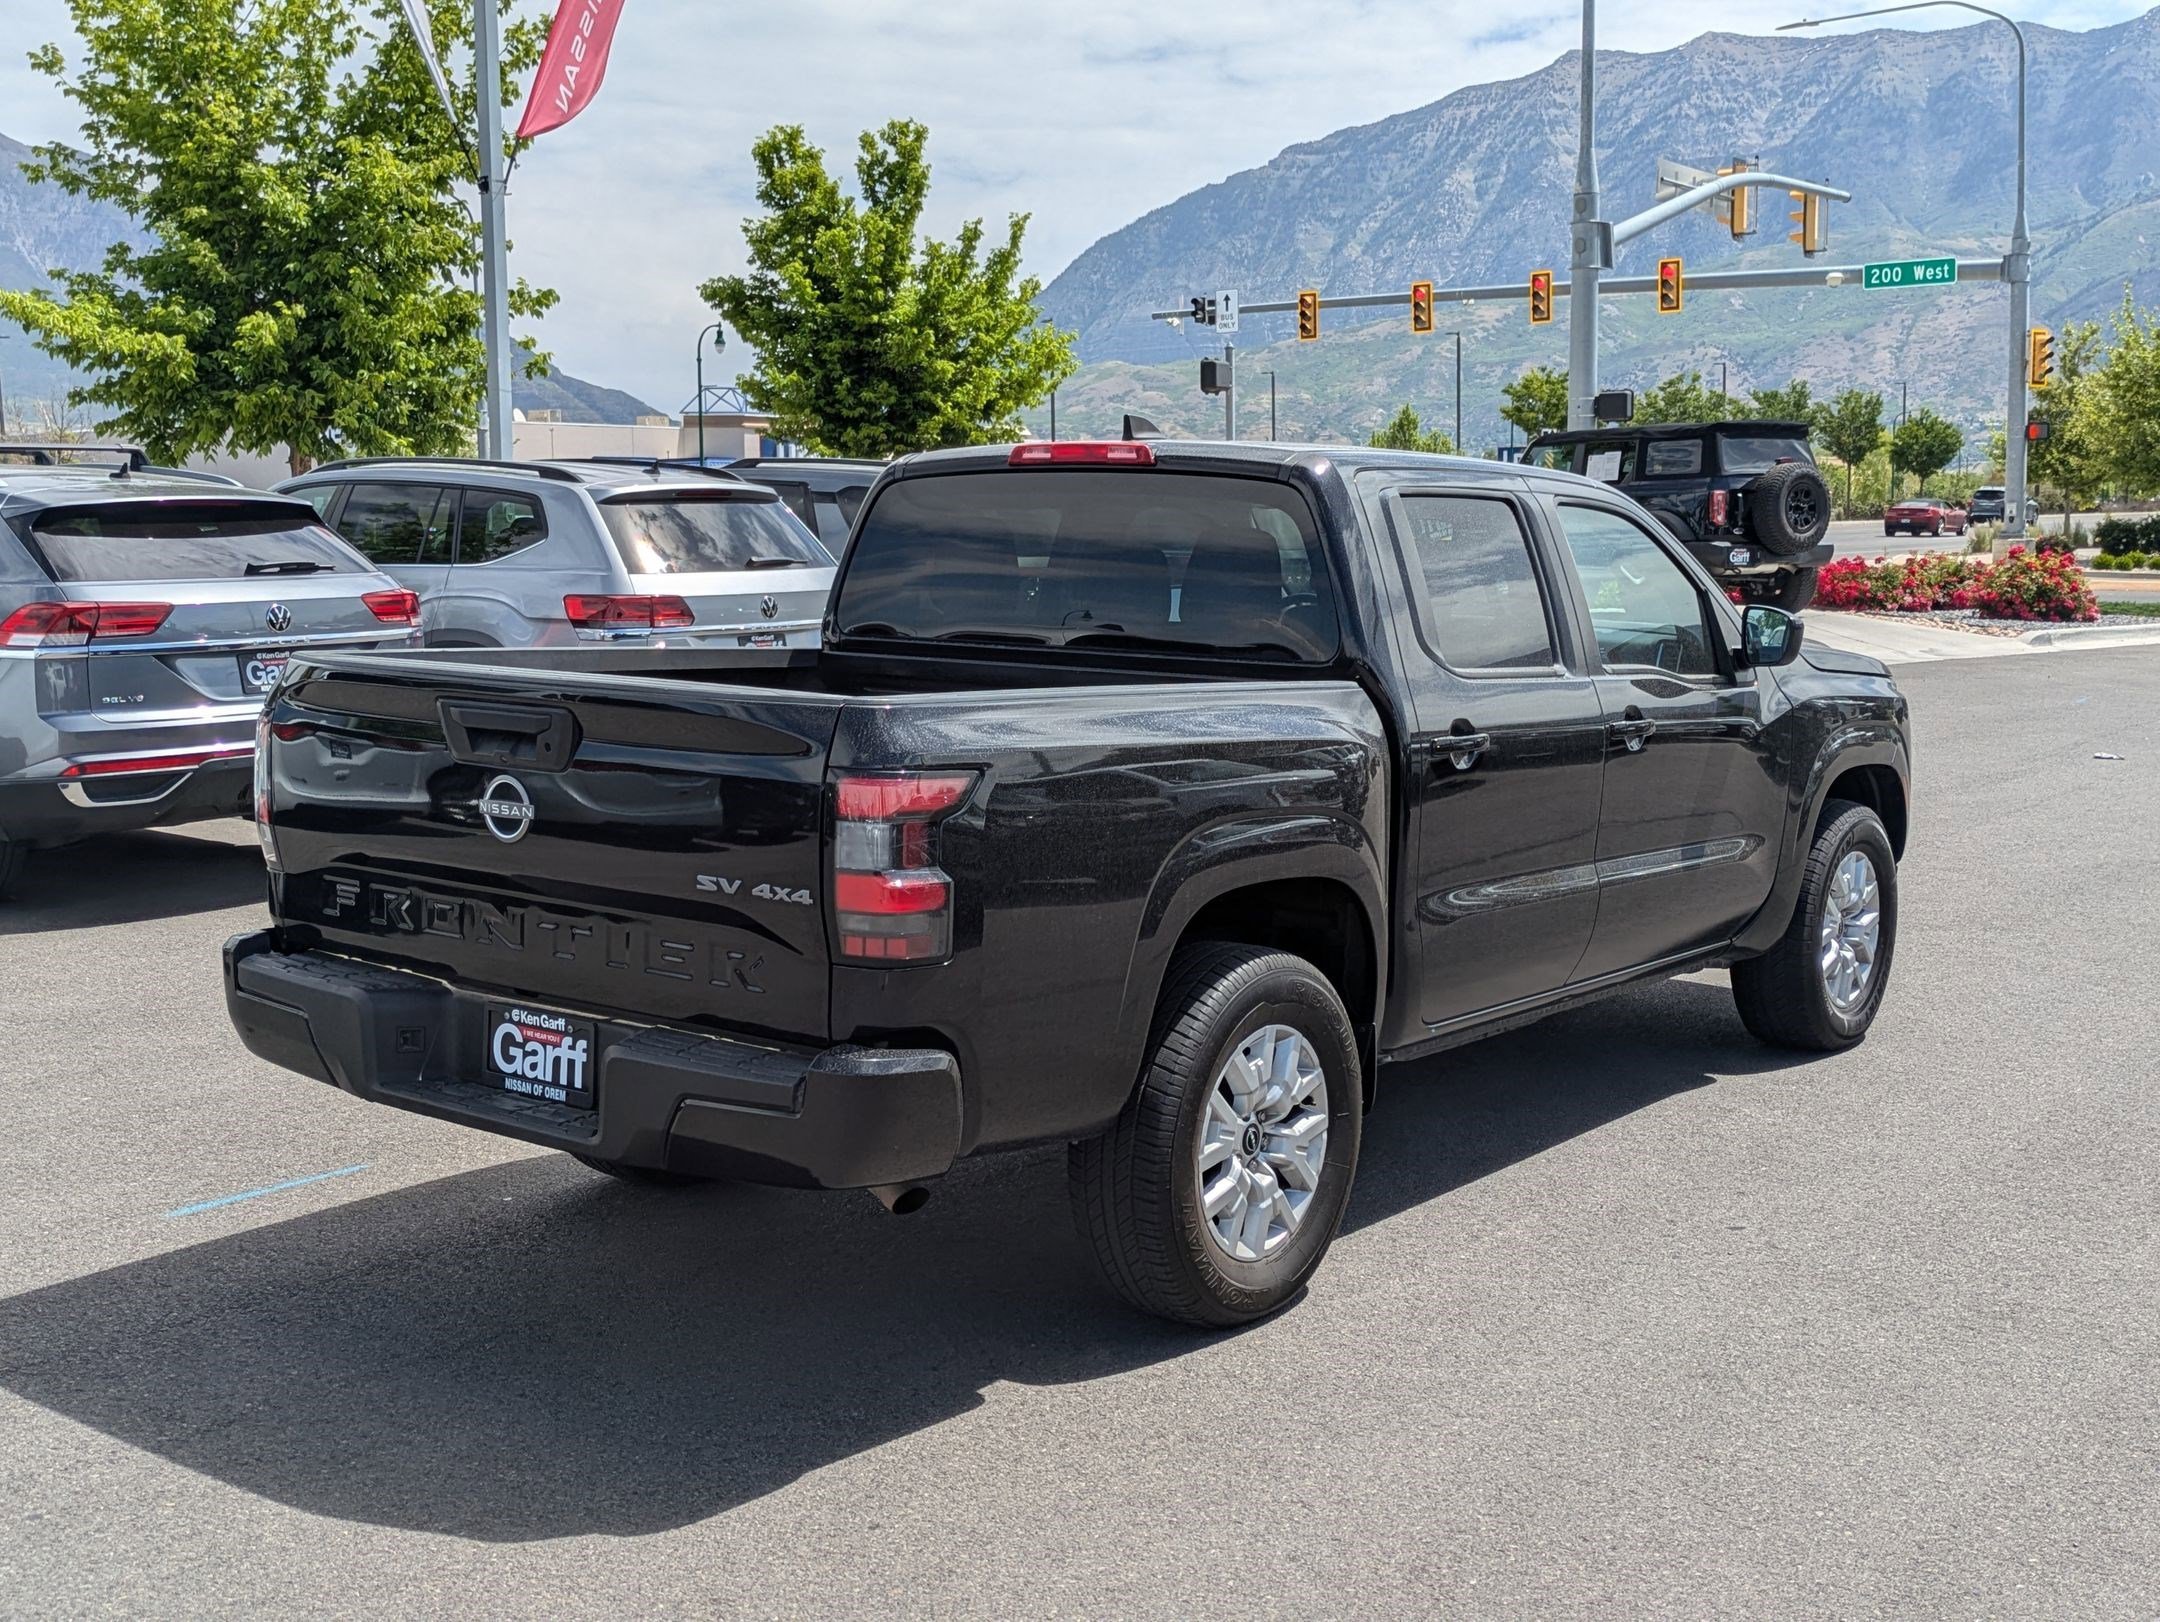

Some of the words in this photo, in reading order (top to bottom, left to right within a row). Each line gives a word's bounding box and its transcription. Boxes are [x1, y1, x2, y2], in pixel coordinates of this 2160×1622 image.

[1871, 267, 1901, 284] 200
[1913, 263, 1950, 281] West
[1218, 321, 1236, 330] ONLY
[480, 802, 533, 817] NISSAN
[696, 874, 742, 895] SV
[322, 874, 766, 994] FRONTIER
[493, 1022, 587, 1089] Garff
[505, 1077, 532, 1095] NISSAN
[533, 1083, 543, 1096] OF
[544, 1086, 566, 1102] OREM
